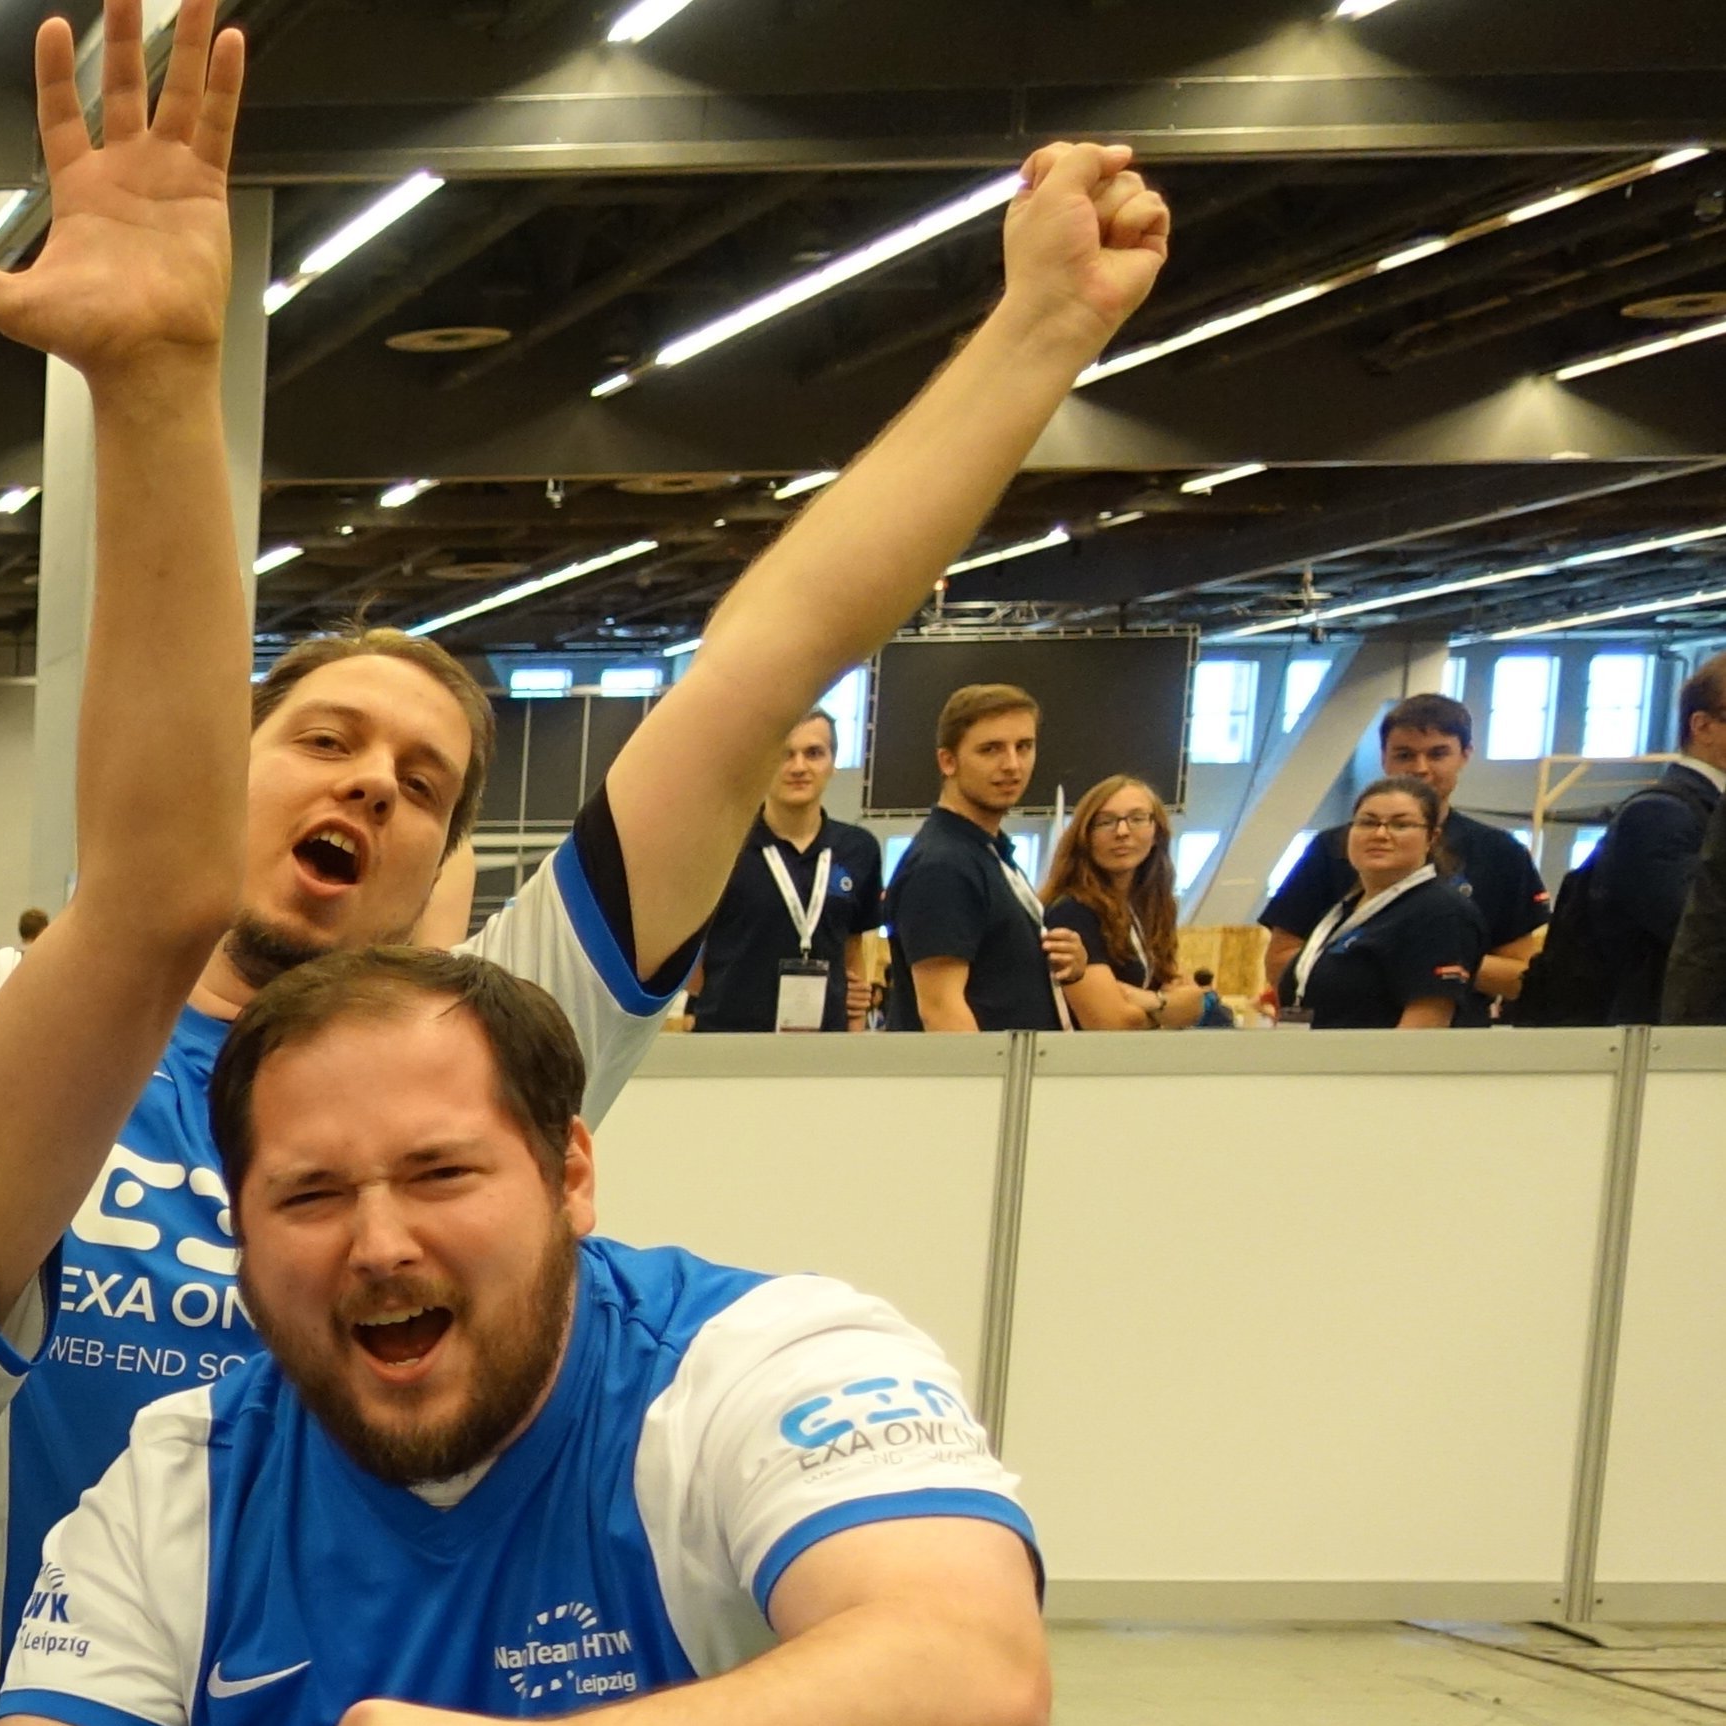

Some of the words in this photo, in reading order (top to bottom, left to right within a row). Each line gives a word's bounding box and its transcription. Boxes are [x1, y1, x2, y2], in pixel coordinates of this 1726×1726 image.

[60, 1266, 156, 1323] EXA
[798, 1430, 876, 1471] EXA
[23, 1631, 91, 1657] Leipzig
[575, 1671, 637, 1696] Leipzig
